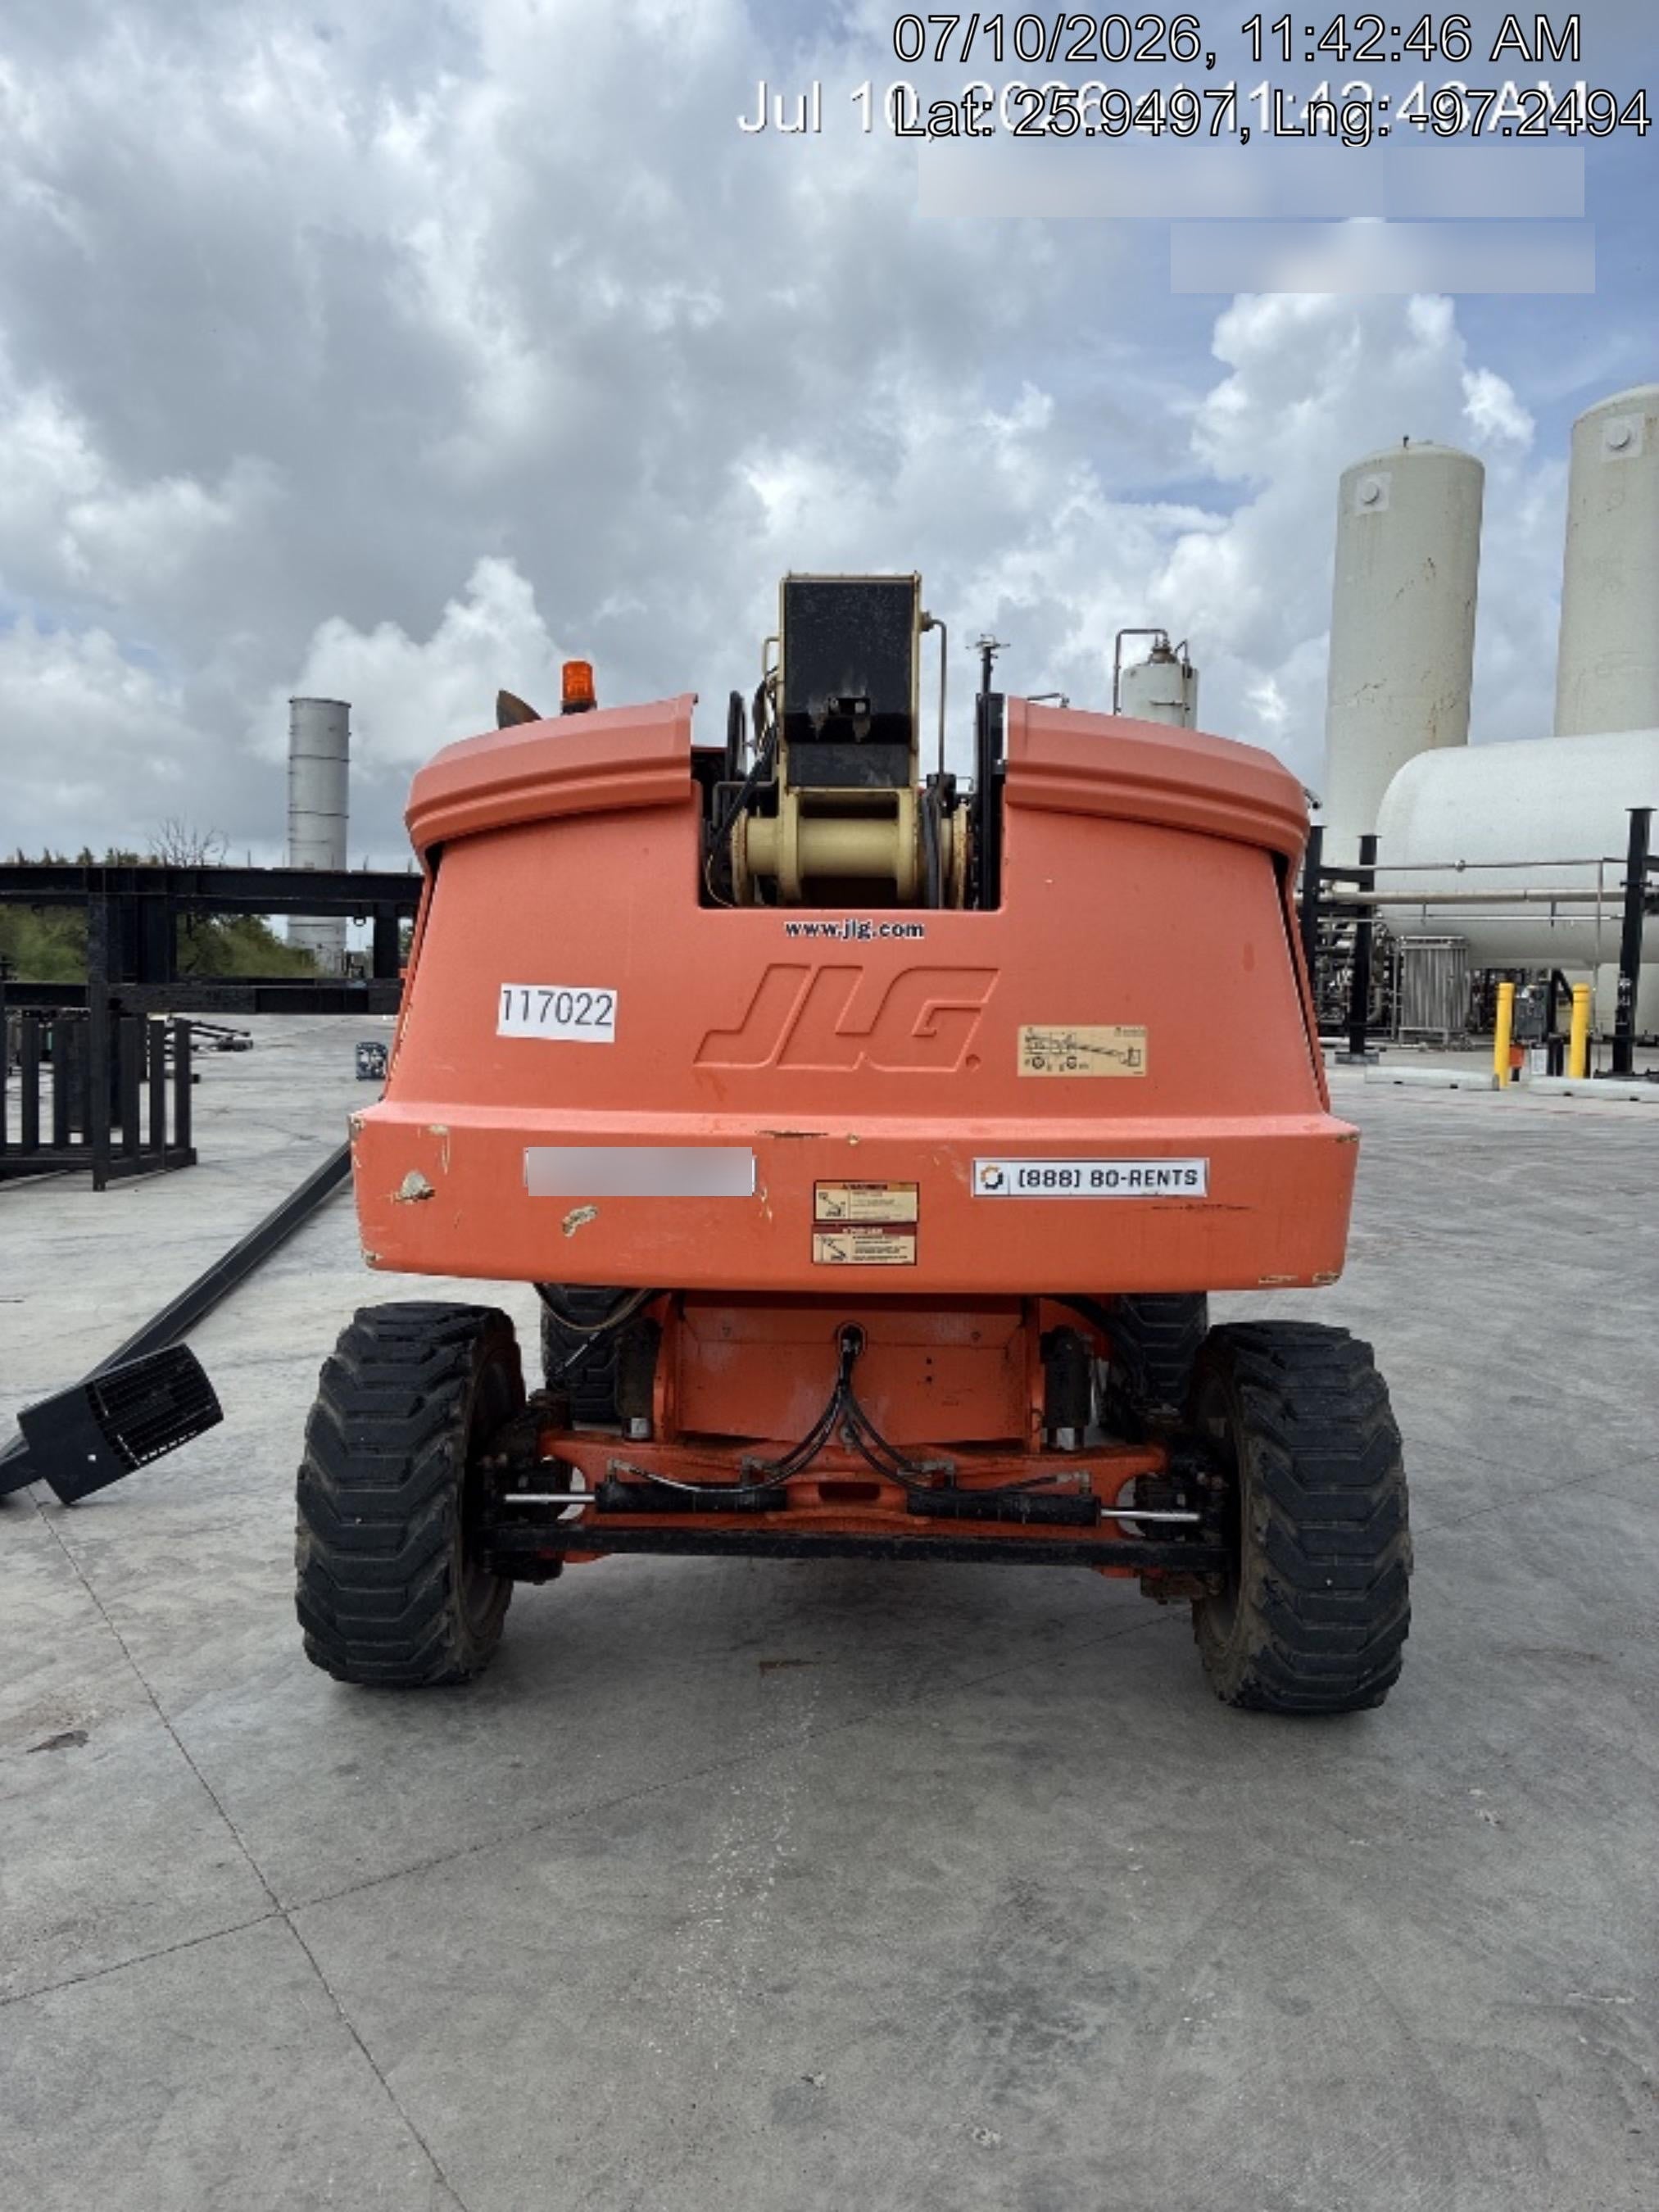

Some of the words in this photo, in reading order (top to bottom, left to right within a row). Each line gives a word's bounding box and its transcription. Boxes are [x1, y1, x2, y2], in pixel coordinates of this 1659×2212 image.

[785, 918, 925, 941] www.jlg.com
[502, 989, 613, 1026] 117022
[693, 963, 1001, 1072] JLG
[1090, 1168, 1199, 1188] 80-RENTS
